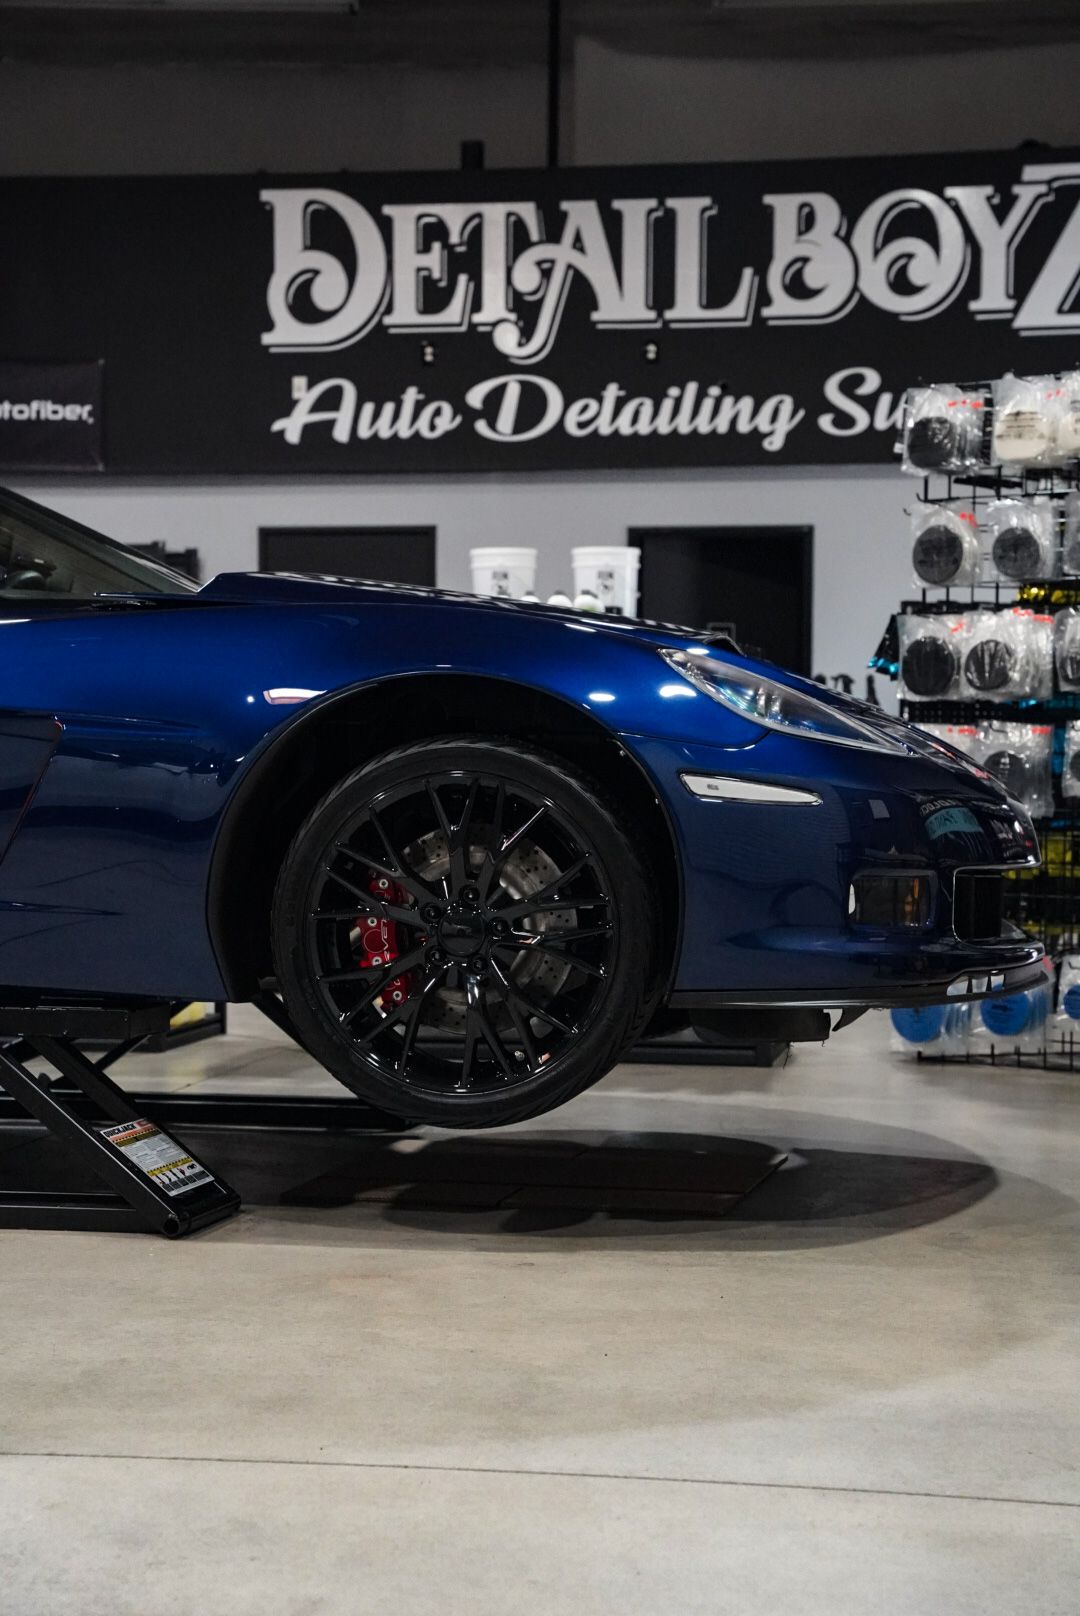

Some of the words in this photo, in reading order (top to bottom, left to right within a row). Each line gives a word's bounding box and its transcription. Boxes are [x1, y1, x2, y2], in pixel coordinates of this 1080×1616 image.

[260, 188, 759, 367] DETAIL
[271, 376, 462, 444] Auto
[465, 374, 804, 452] Detailing
